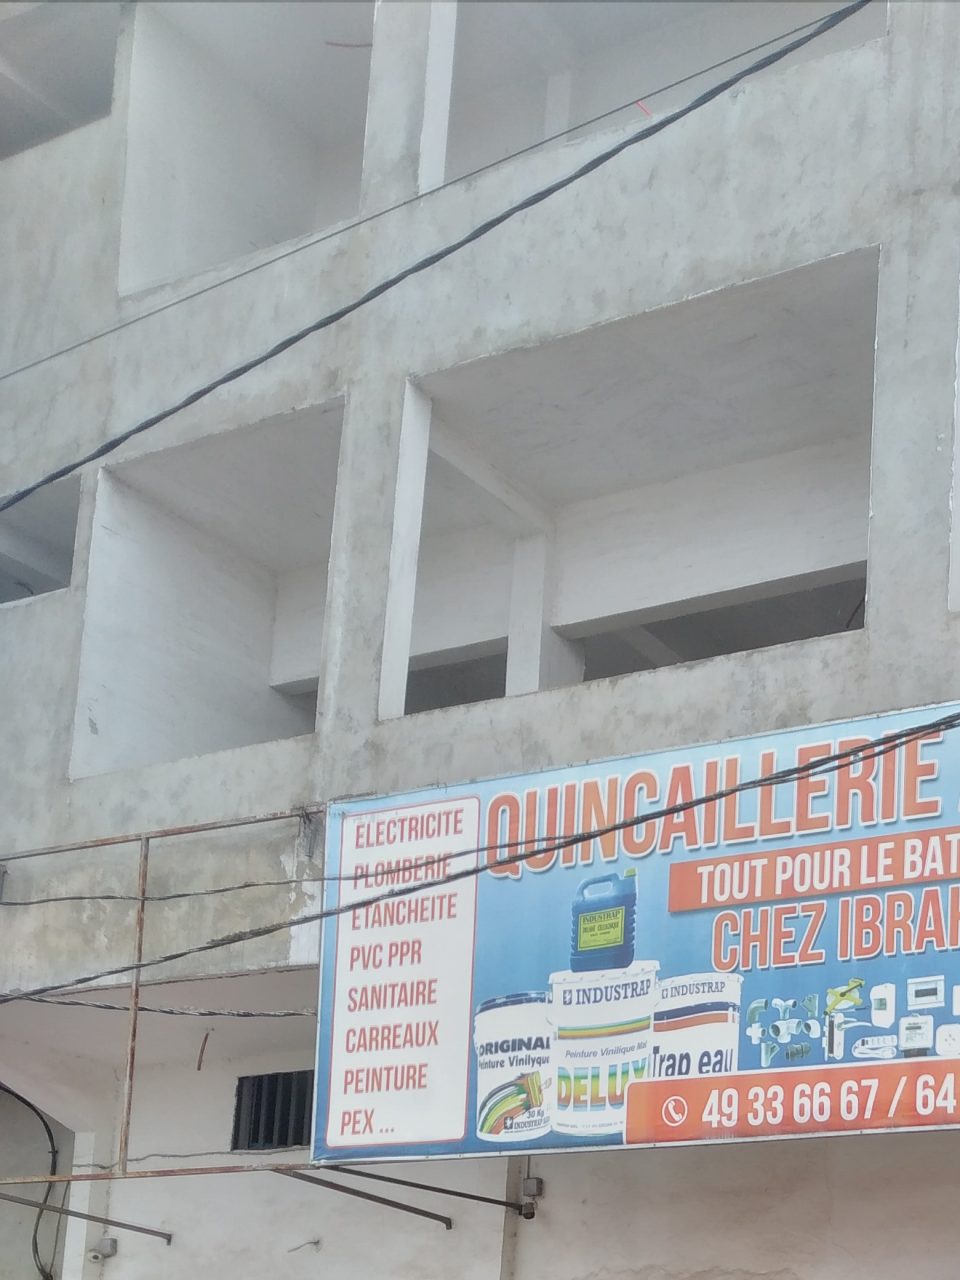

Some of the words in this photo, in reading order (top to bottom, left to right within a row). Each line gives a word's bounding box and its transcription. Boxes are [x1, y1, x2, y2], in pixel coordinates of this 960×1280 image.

[487, 726, 943, 878] QUINCAILLERIE
[355, 809, 464, 849] ELECTRICITE
[353, 852, 452, 890] PLOMBERIE
[697, 858, 768, 904] TOUT
[774, 847, 851, 895] POUR
[859, 842, 895, 886] LE
[351, 893, 458, 931] ETANCHEITE
[711, 899, 827, 972] CHEZ
[349, 943, 383, 972] PVC
[388, 938, 422, 967] PPR
[347, 978, 438, 1012] SANITAIRE
[575, 978, 651, 1005] INDUSTRAP
[670, 981, 726, 999] INDUSTRAP
[345, 1020, 439, 1053] CARREAUX
[564, 1048, 598, 1059] Peinture
[343, 1063, 428, 1095] PEINTURE
[702, 1088, 738, 1128] 49
[747, 1084, 784, 1126] 33
[793, 1081, 831, 1124] 66
[840, 1078, 880, 1122] 67
[888, 1076, 908, 1118] /
[915, 1072, 957, 1115] 64
[340, 1108, 375, 1136] PEX
